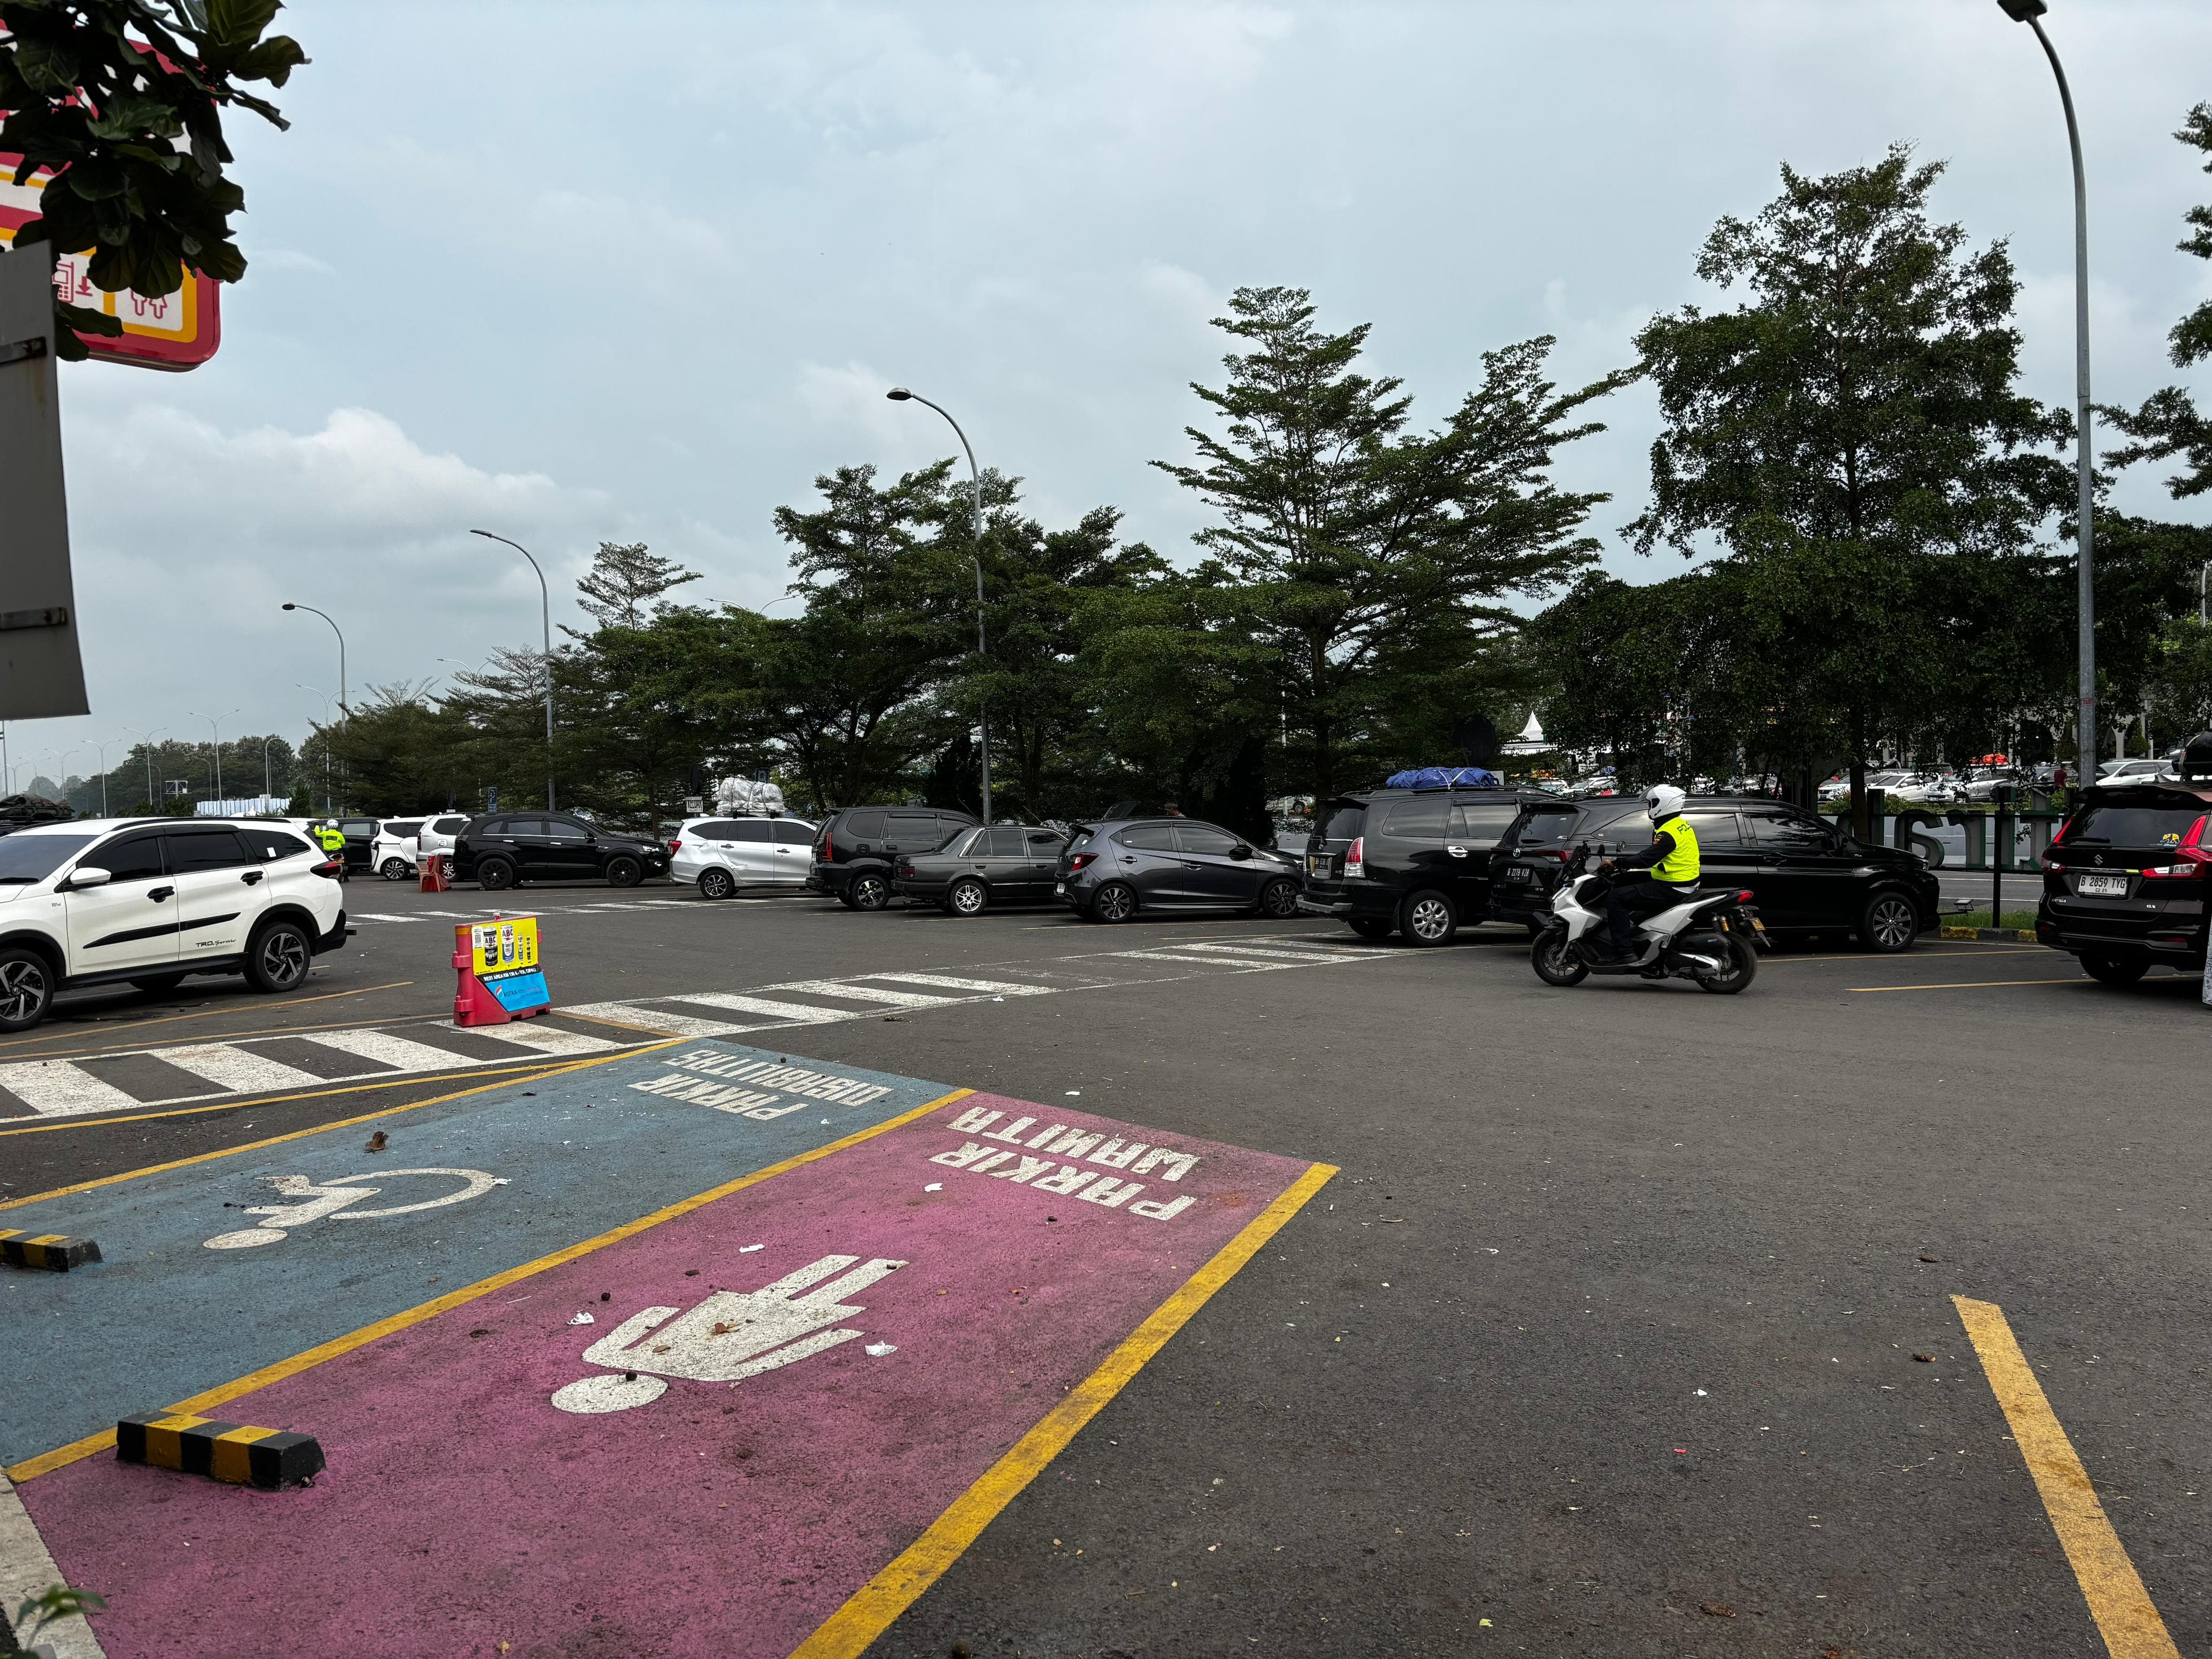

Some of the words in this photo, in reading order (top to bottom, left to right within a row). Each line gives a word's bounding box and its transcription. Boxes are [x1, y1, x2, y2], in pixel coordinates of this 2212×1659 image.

[2081, 876, 2086, 886] B
[2089, 877, 2108, 888] 2859
[2112, 878, 2126, 889] TYG
[502, 929, 513, 937] ABC
[627, 1073, 809, 1121] PARKIR
[660, 1050, 894, 1107] DISABILITAS
[946, 1107, 1202, 1182] WANITA
[929, 1142, 1197, 1221] PARKIR
